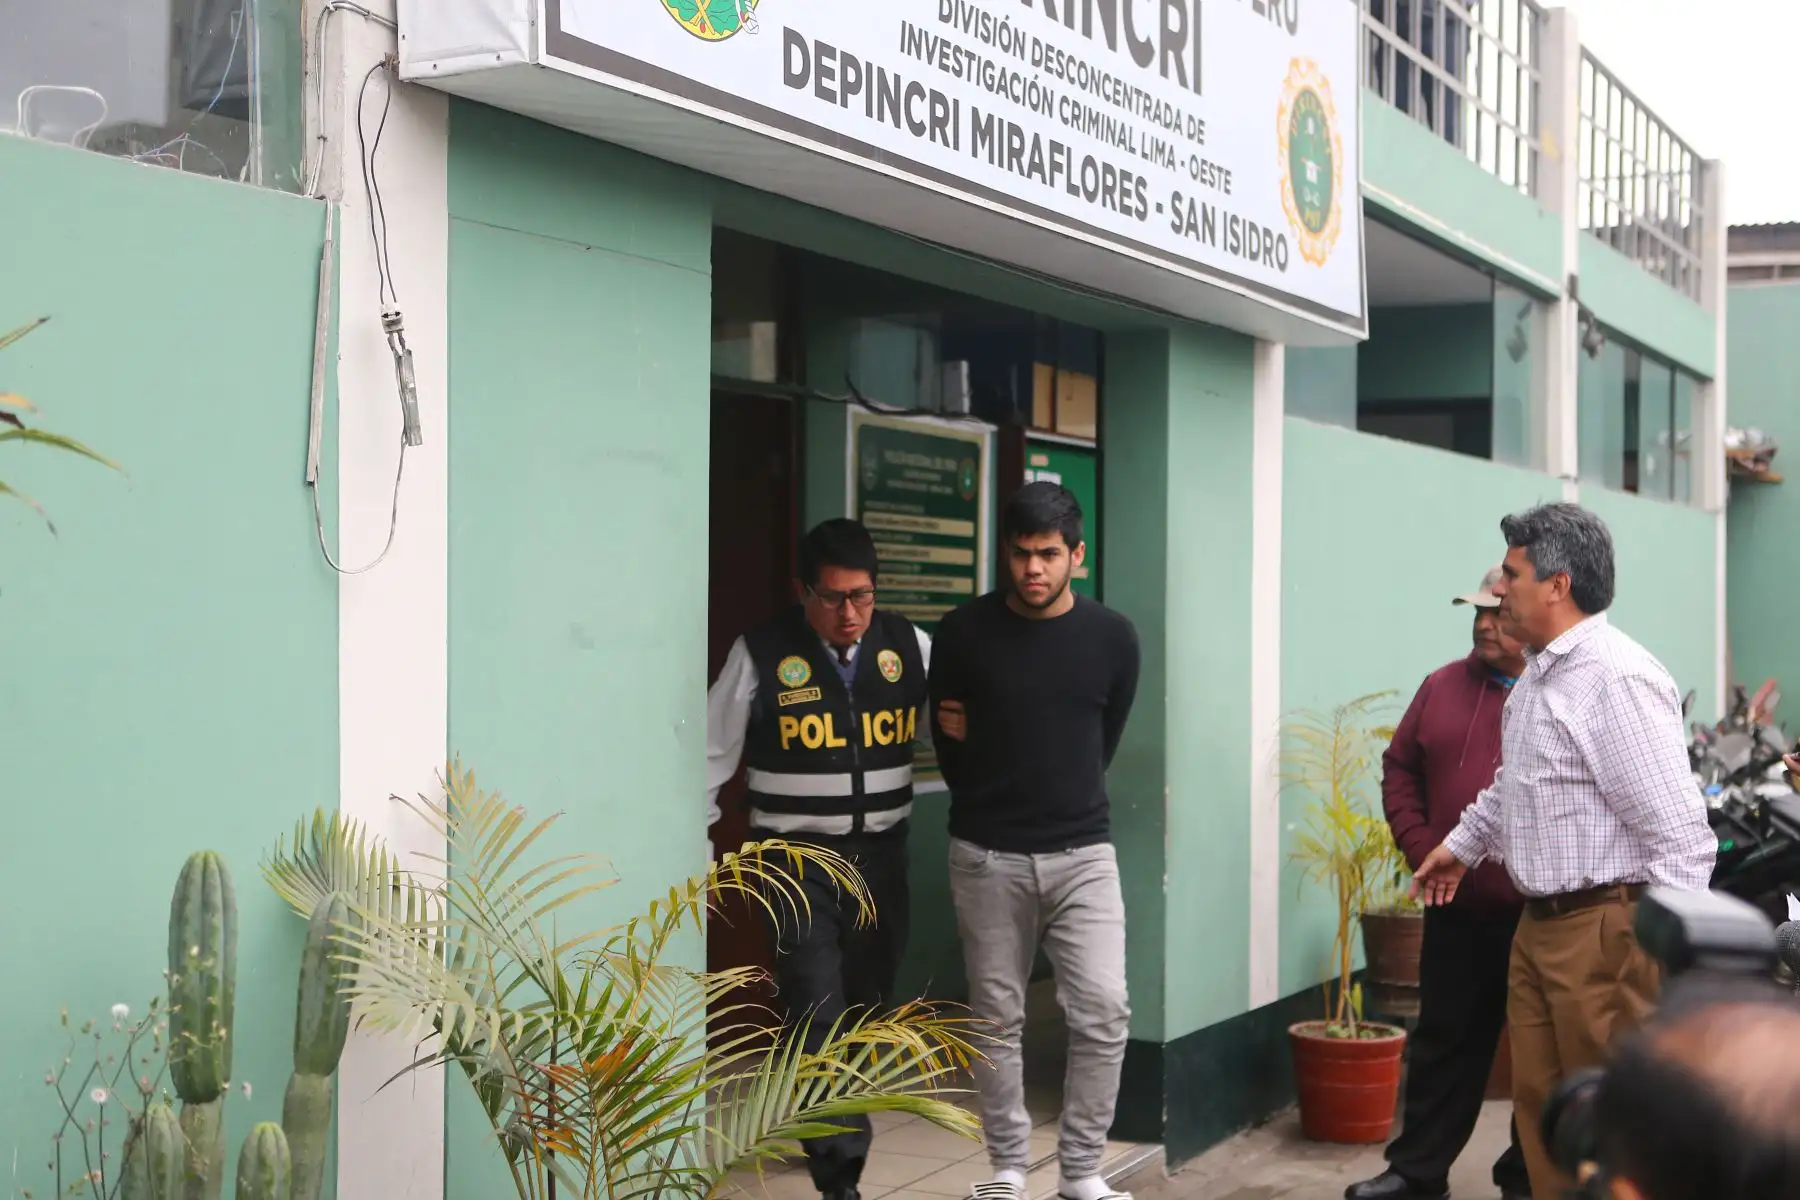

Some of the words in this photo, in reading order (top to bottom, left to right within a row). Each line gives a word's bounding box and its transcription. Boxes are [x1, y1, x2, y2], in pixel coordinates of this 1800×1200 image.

[783, 25, 959, 151] DEPINCRI
[971, 105, 1148, 222] MIRAFLORES
[1170, 190, 1216, 248] SAN
[1223, 210, 1288, 274] ISIDRO
[900, 20, 1054, 118] INVESTIGACIÓN
[1059, 94, 1136, 155] CRIMINAL
[1141, 131, 1176, 172] LIMA
[1189, 153, 1232, 195] OESTE
[939, 0, 1026, 61] DIVISIÓN
[1031, 36, 1183, 136] DESCONCENTRADA
[1187, 113, 1205, 145] DE
